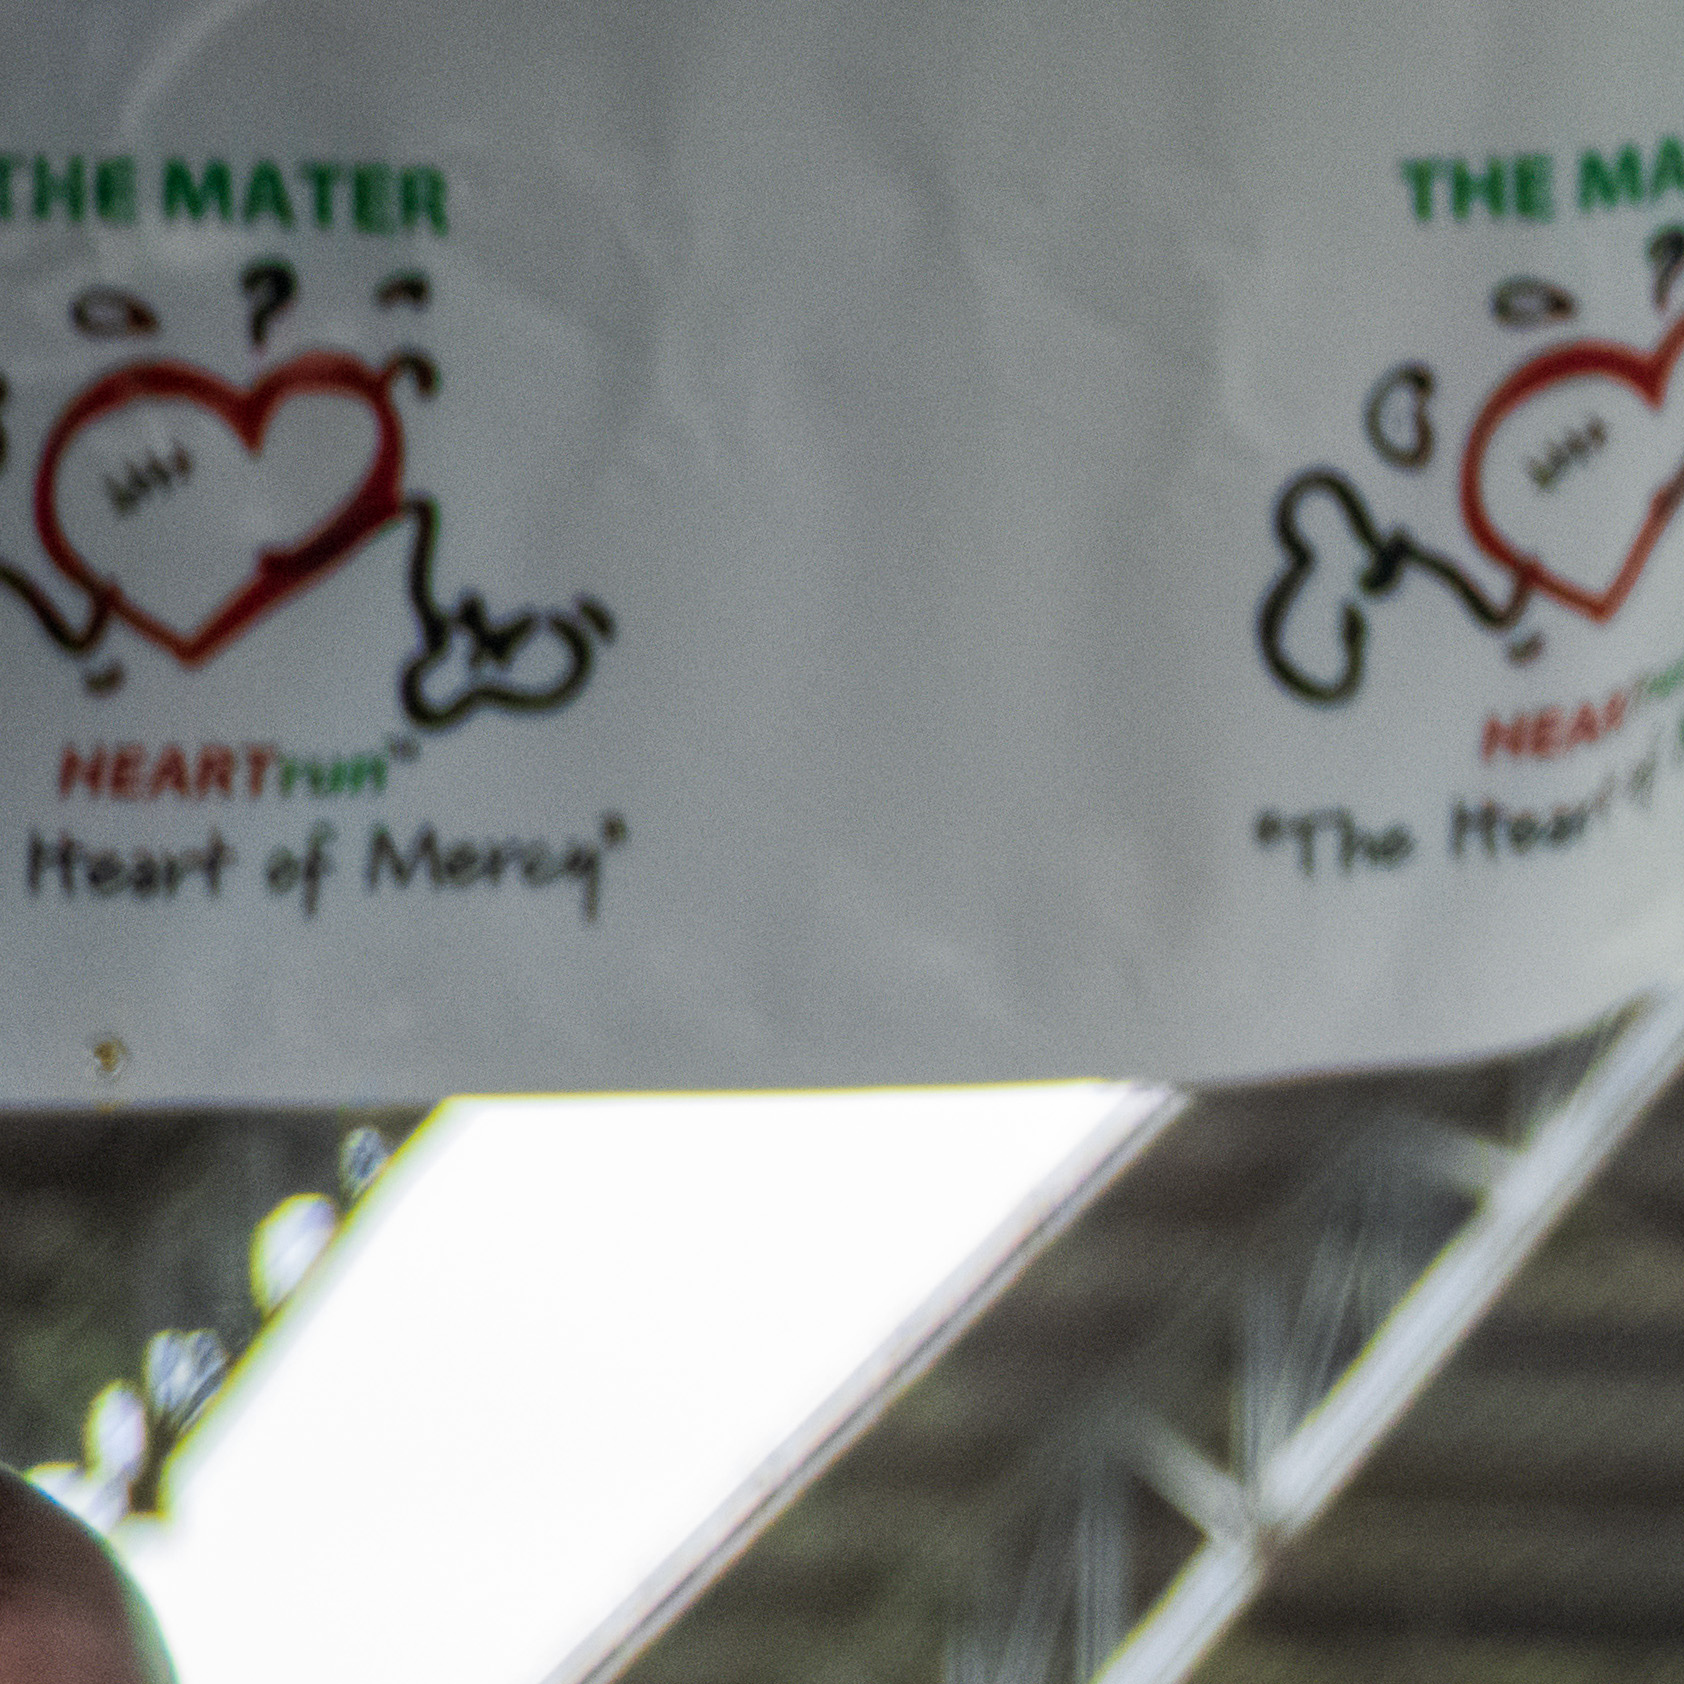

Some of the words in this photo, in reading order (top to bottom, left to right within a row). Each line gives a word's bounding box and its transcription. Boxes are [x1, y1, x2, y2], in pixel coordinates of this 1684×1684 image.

[163, 155, 449, 236] MATER
[1400, 153, 1554, 223] THE
[26, 821, 235, 898] Heart
[265, 816, 335, 919] of
